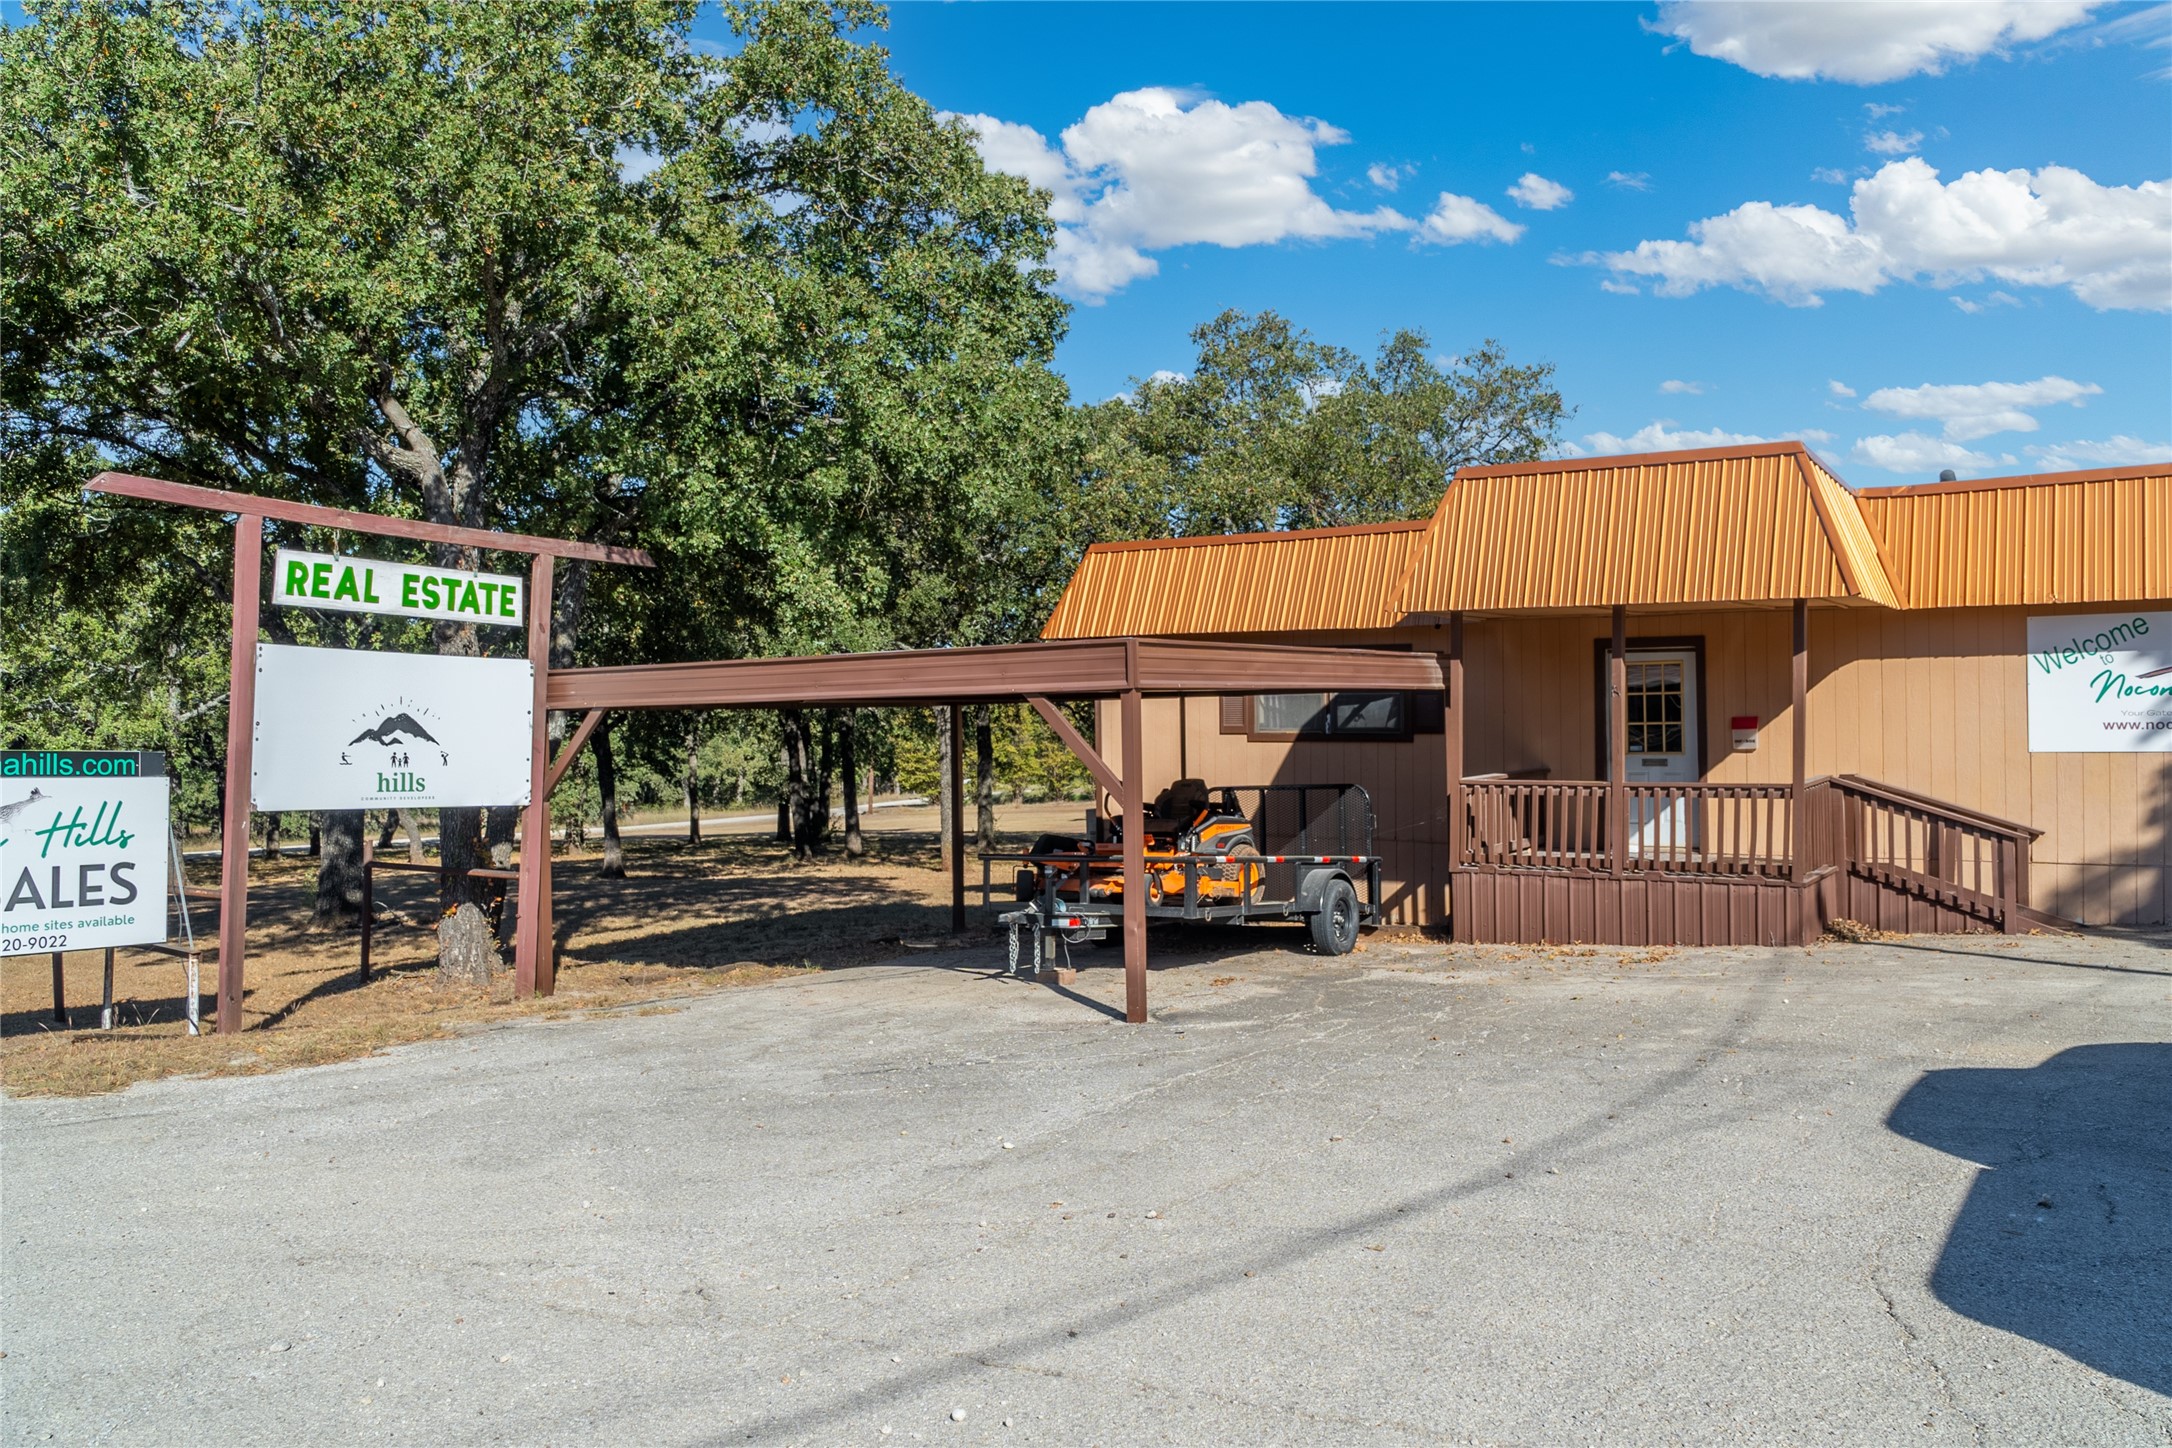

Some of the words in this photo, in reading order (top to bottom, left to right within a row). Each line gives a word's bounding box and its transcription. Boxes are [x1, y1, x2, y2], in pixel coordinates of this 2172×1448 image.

[285, 560, 380, 604] REAL
[402, 573, 517, 617] ESTATE
[2033, 617, 2150, 674] Welcome
[2100, 654, 2115, 666] to
[0, 752, 136, 776] ahills.com
[376, 772, 426, 793] hills
[35, 800, 136, 859] Hills
[0, 861, 138, 912] ALES
[1, 923, 40, 934] home
[44, 920, 74, 931] sites
[78, 914, 136, 929] available
[2, 934, 68, 952] 20-9022
